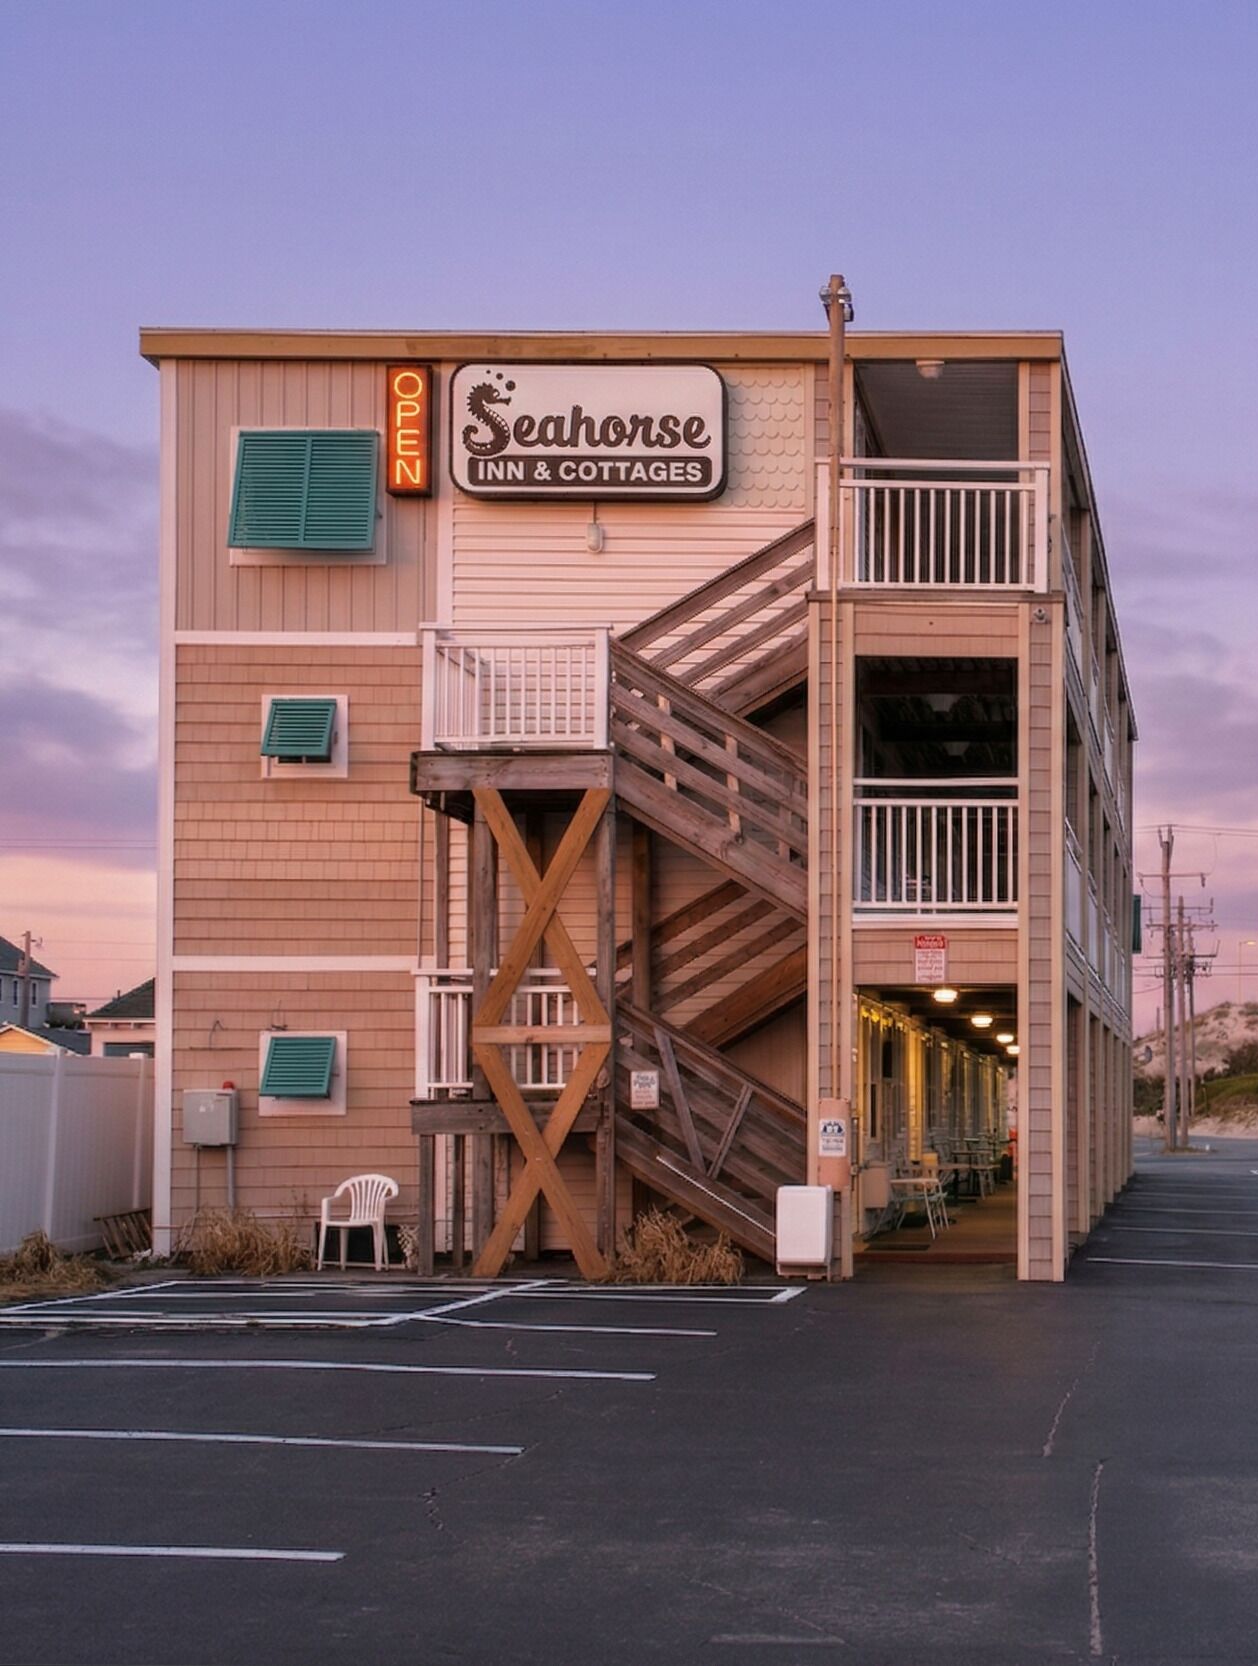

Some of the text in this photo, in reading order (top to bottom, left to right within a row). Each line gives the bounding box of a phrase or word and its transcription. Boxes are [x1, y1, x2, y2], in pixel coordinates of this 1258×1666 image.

[394, 371, 423, 485] OPEN
[462, 382, 712, 457] Seahorse
[478, 460, 703, 482] INN & COTTAGES
